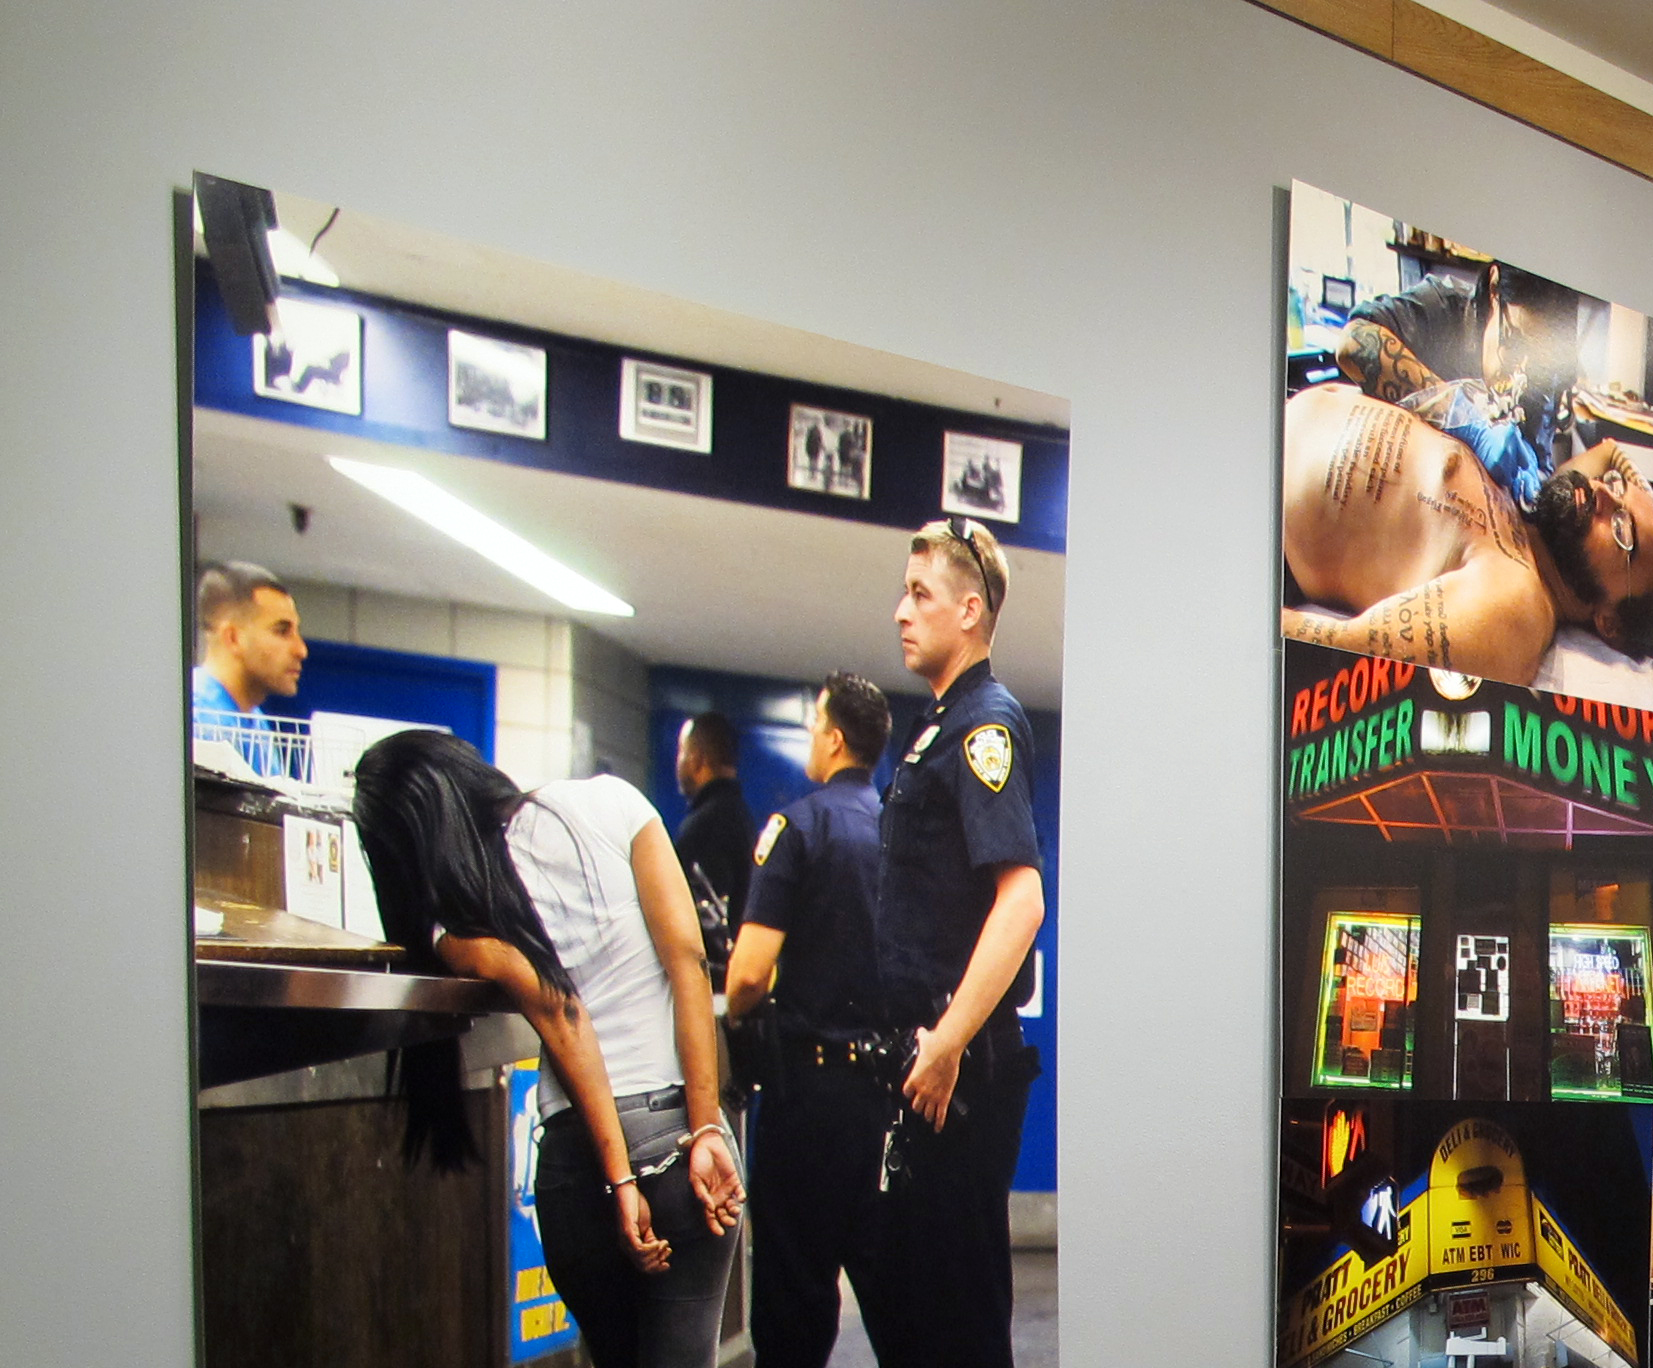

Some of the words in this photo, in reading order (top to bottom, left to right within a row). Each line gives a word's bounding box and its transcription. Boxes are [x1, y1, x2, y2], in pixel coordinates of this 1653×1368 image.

[1289, 699, 1415, 800] TRANSFER
[1347, 975, 1405, 999] RECORD
[1442, 1246, 1465, 1265] ATM
[1469, 1244, 1493, 1262] EBT
[1501, 1242, 1521, 1258] WIC
[1322, 1247, 1411, 1337] GROCERY
[1471, 1267, 1495, 1283] 296
[1353, 1304, 1391, 1336] BREAKFAST
[1395, 1284, 1422, 1309] COFFEE
